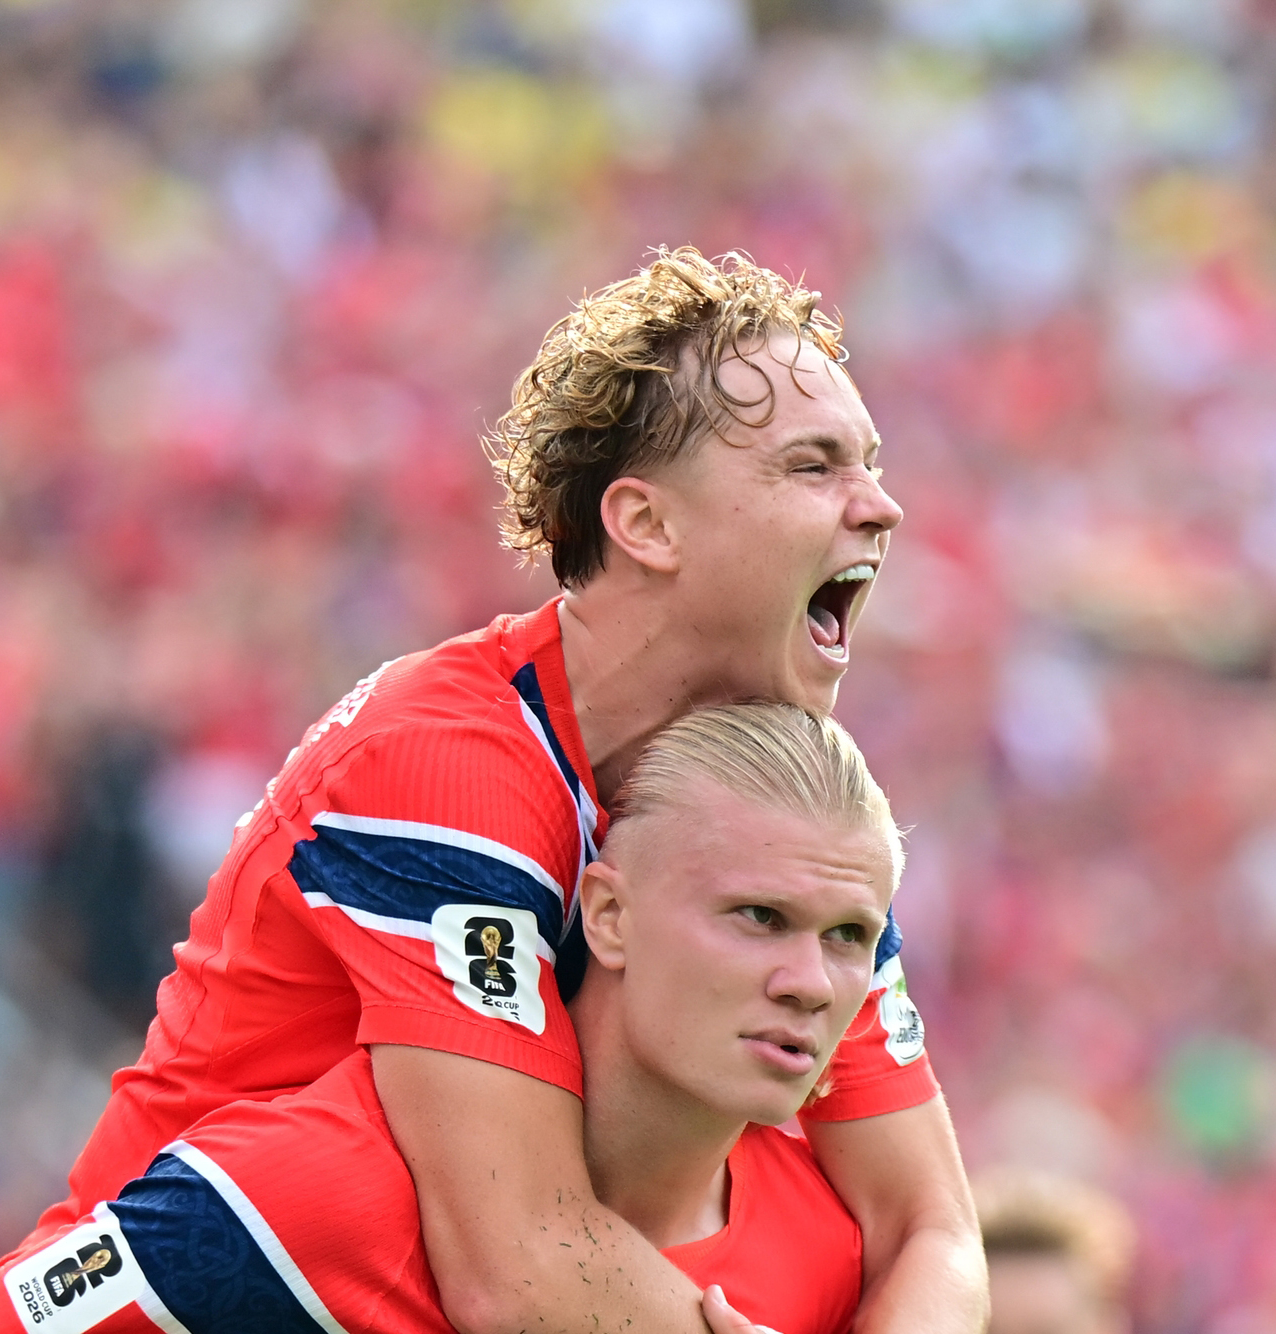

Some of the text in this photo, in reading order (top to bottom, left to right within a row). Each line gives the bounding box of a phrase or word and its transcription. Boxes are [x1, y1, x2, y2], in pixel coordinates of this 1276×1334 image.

[18, 1281, 45, 1324] 2026
[31, 1276, 54, 1317] WORLD CUP
[49, 1275, 65, 1298] FIFA
